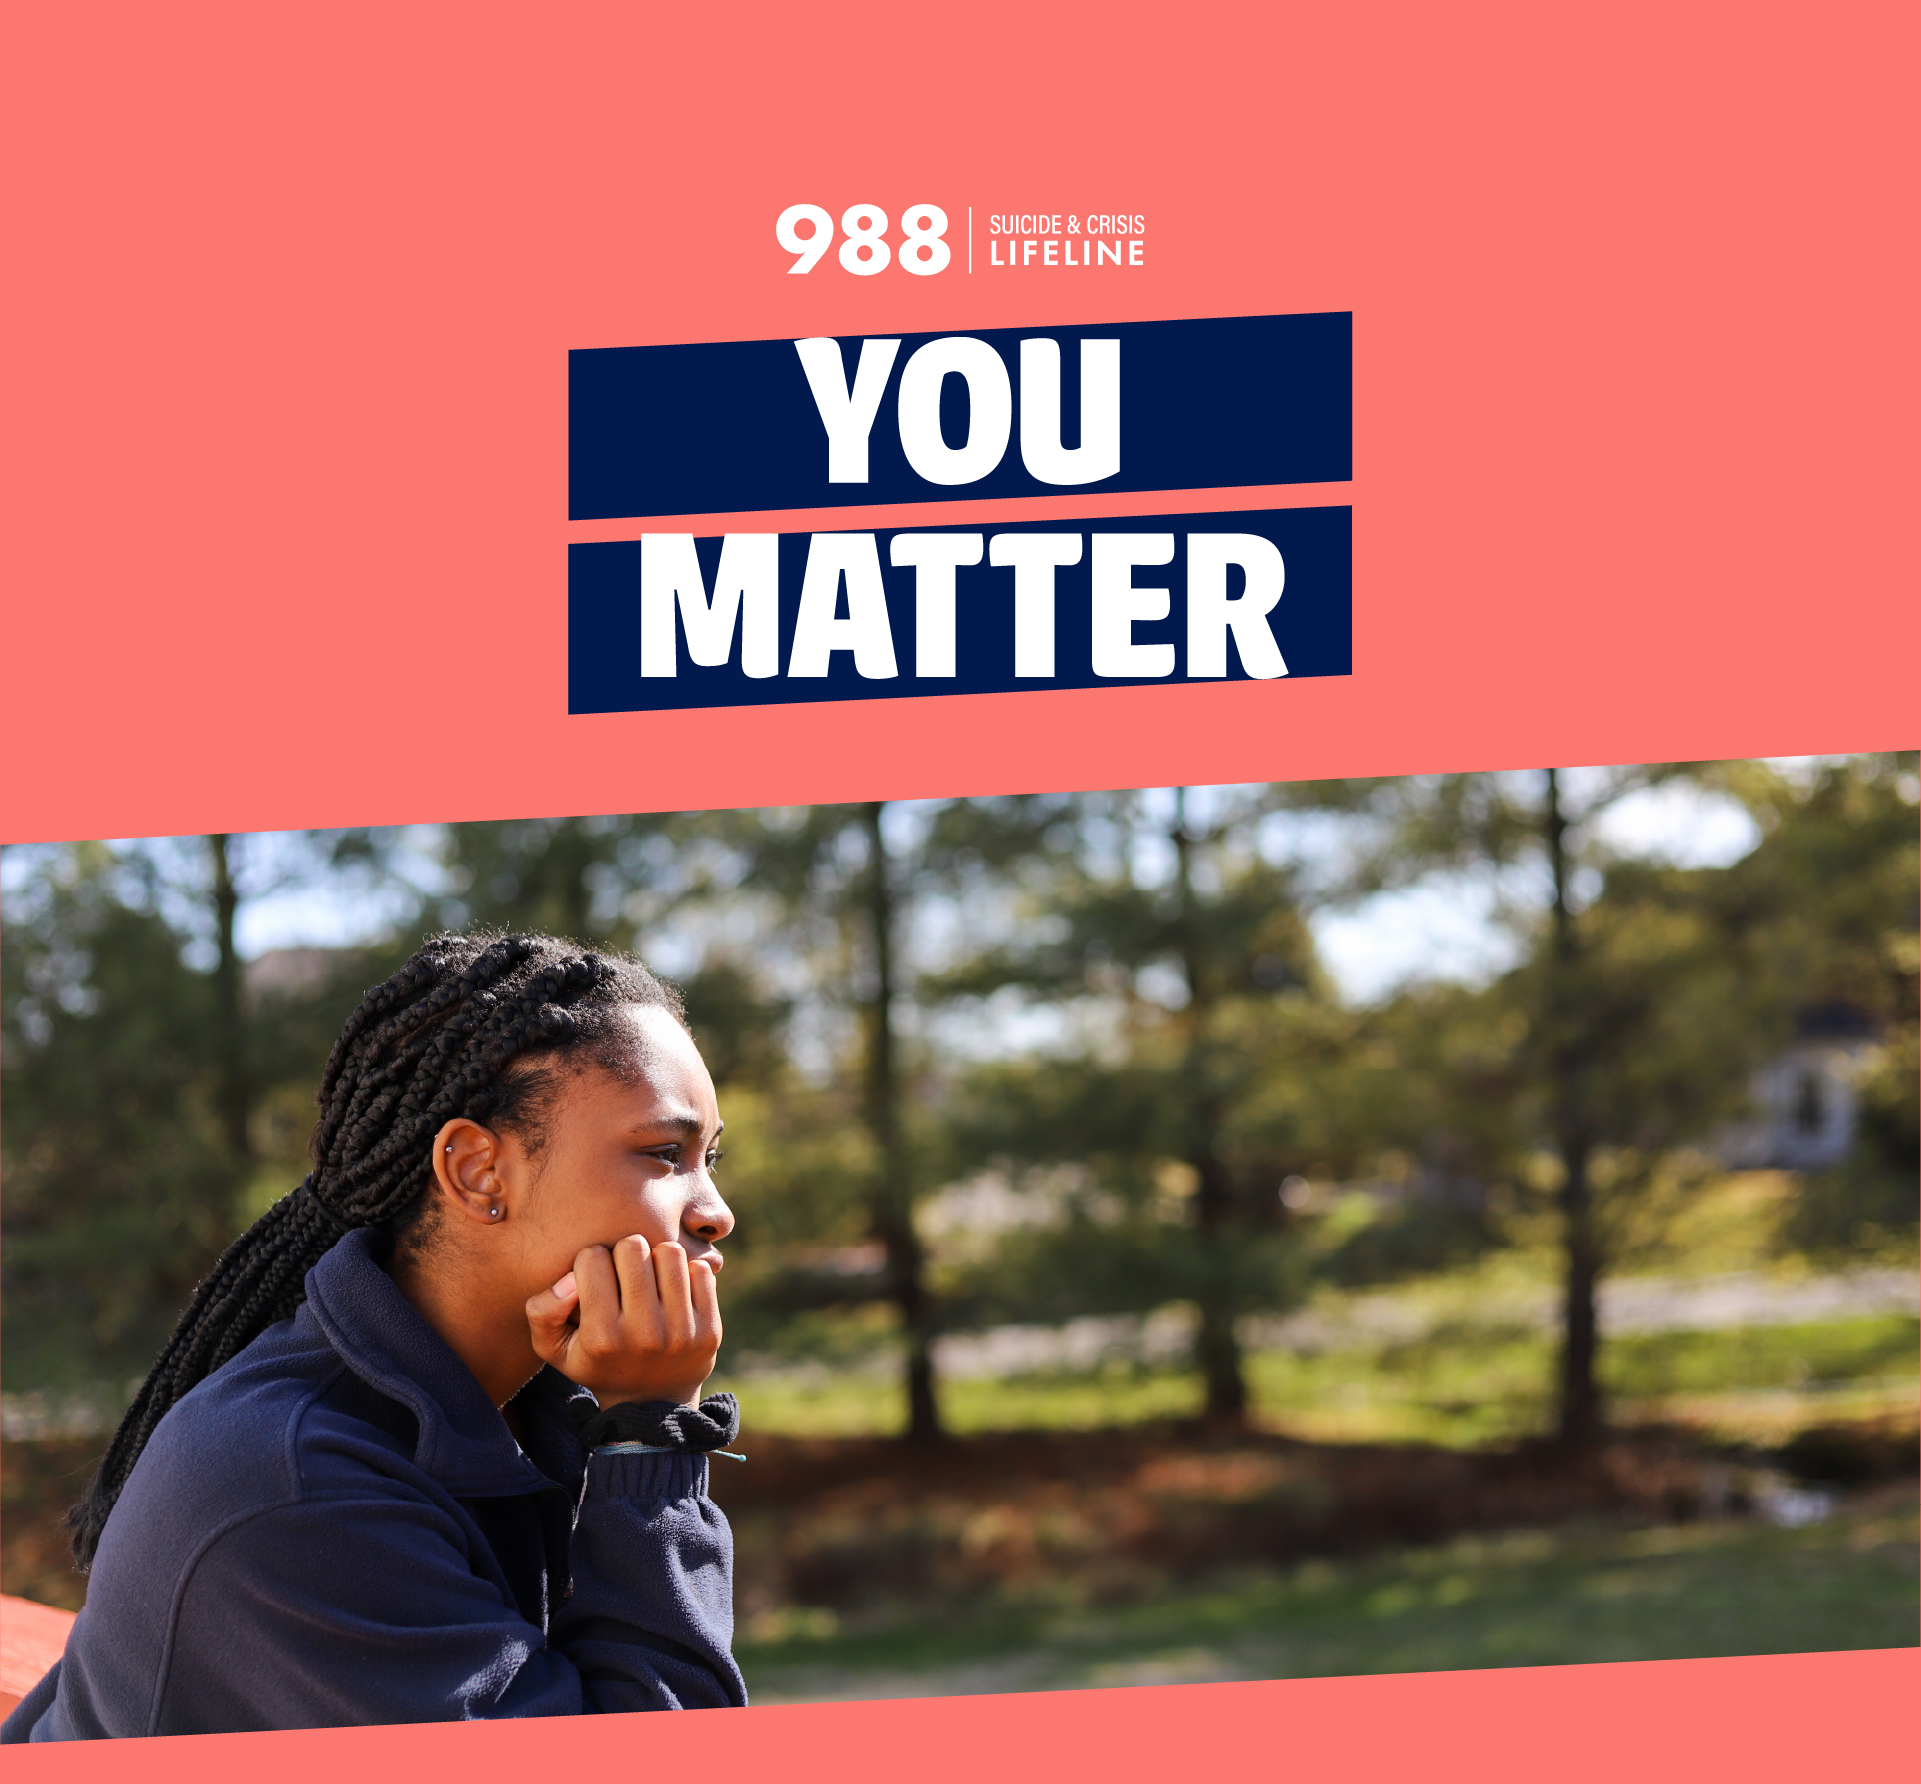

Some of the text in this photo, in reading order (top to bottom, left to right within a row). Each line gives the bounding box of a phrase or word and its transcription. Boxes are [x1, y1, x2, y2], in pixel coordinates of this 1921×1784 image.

[775, 203, 951, 276] 988
[989, 214, 1145, 235] SUICIDE & CRISIS
[990, 240, 1144, 266] LIFELINE
[793, 336, 1121, 486] YOU
[640, 533, 1289, 680] MATTER
